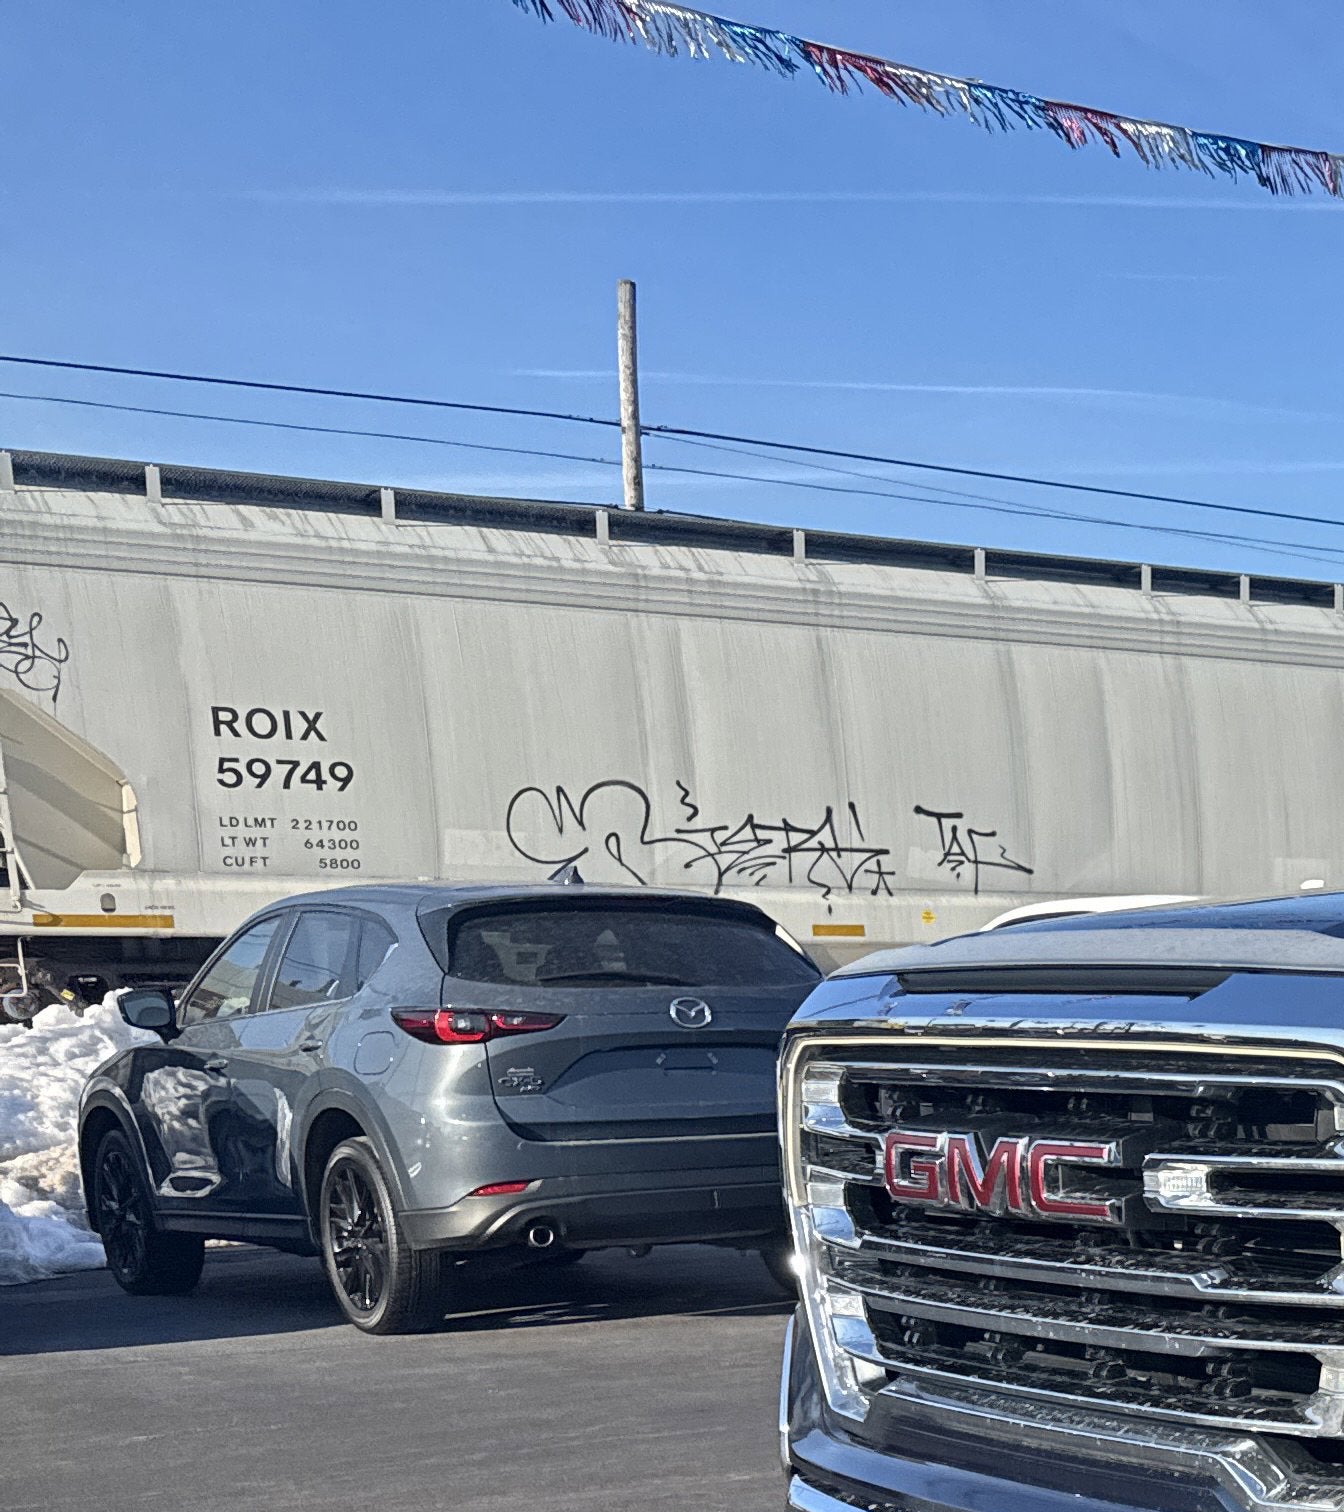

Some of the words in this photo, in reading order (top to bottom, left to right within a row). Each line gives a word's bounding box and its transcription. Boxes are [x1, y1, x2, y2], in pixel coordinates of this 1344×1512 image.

[211, 705, 328, 742] ROIX
[216, 757, 354, 792] 59749
[219, 816, 239, 828] LD
[244, 817, 277, 829] LMT
[290, 818, 358, 832] 221700
[220, 836, 238, 848] LT
[243, 836, 270, 848] WT
[304, 838, 360, 851] 64300
[222, 855, 245, 868] CU
[249, 856, 270, 868] FT
[319, 858, 361, 870] 5800
[884, 1128, 1125, 1225] GMC
